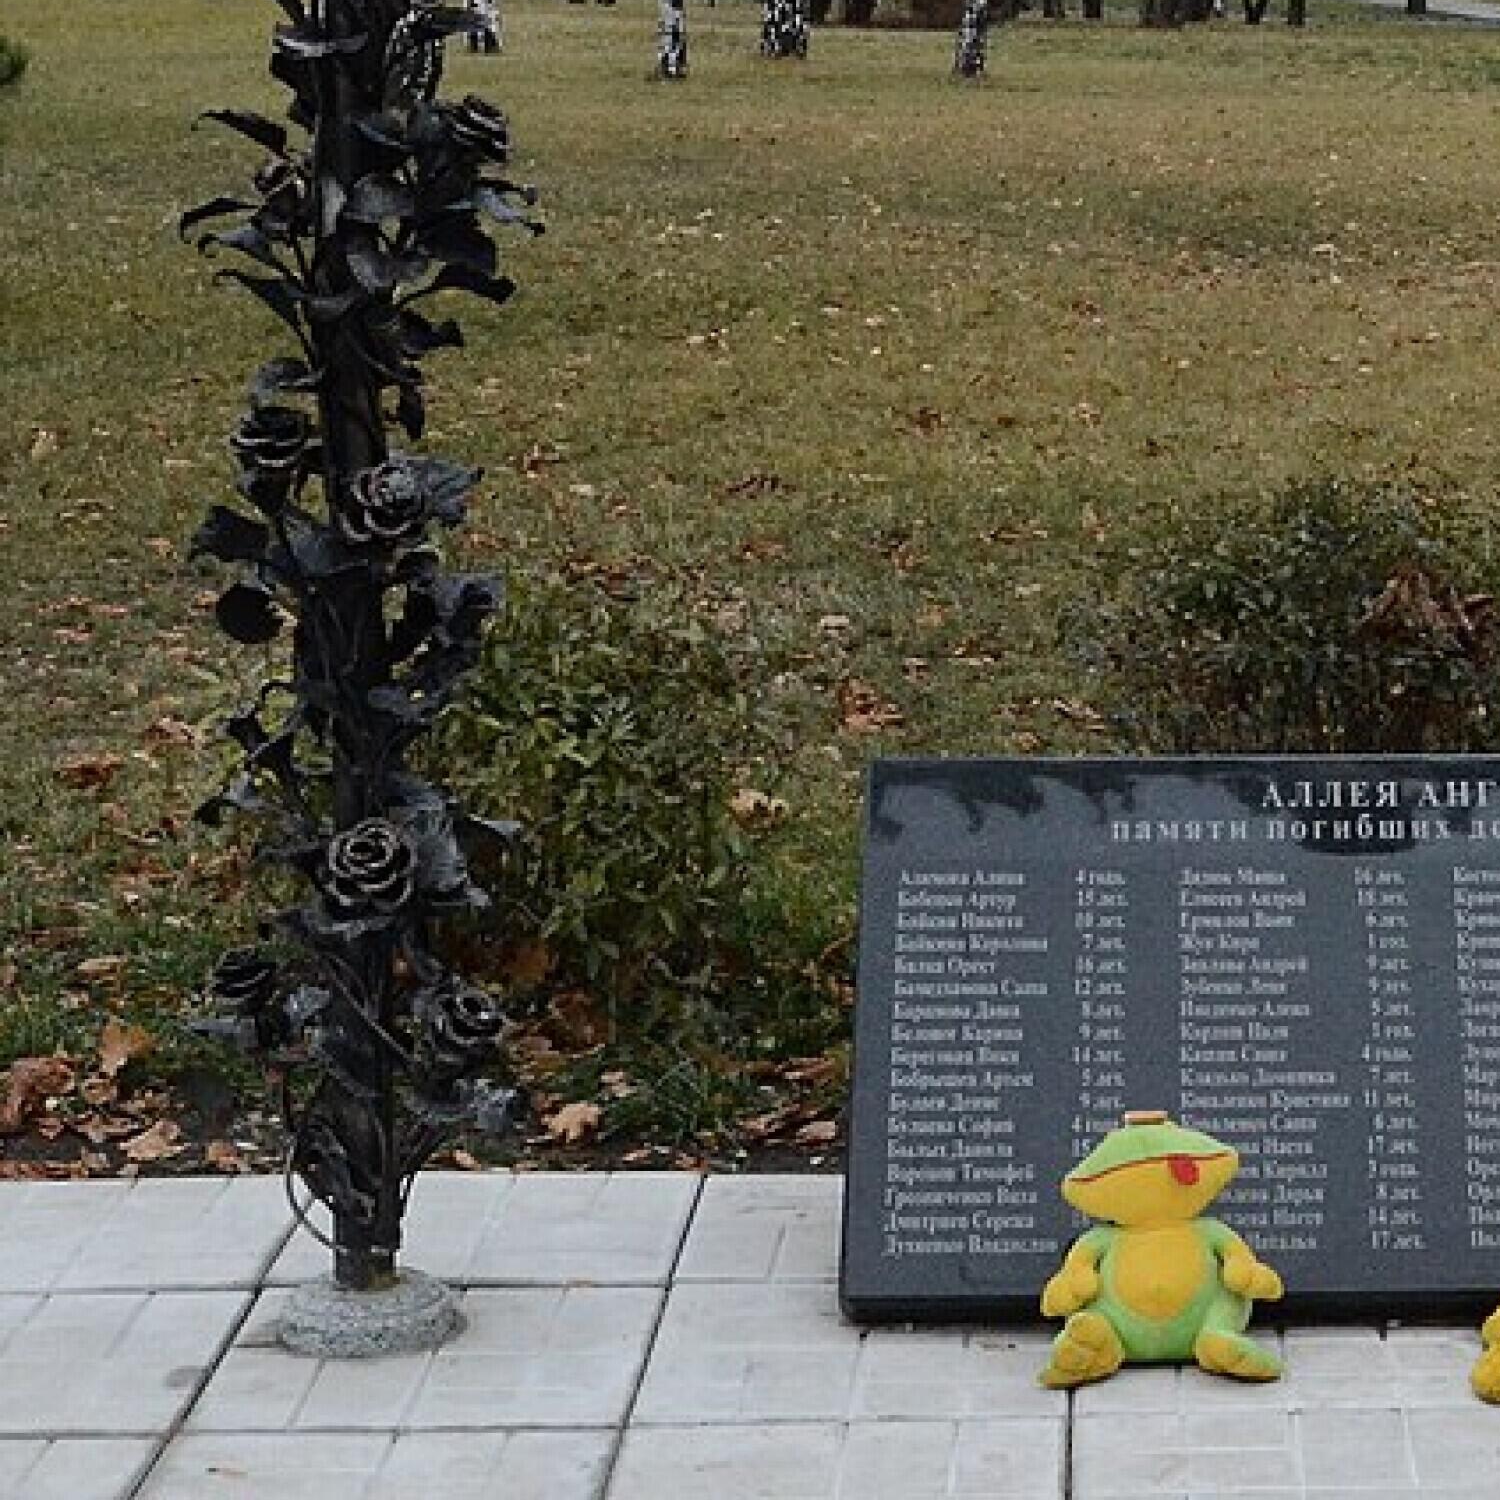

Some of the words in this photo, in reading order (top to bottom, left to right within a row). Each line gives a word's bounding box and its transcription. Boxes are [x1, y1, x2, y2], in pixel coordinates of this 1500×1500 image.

[1261, 781, 1399, 808] АЛЛЕЯ
[1111, 819, 1249, 841] памяти
[1267, 813, 1451, 841] погибших
